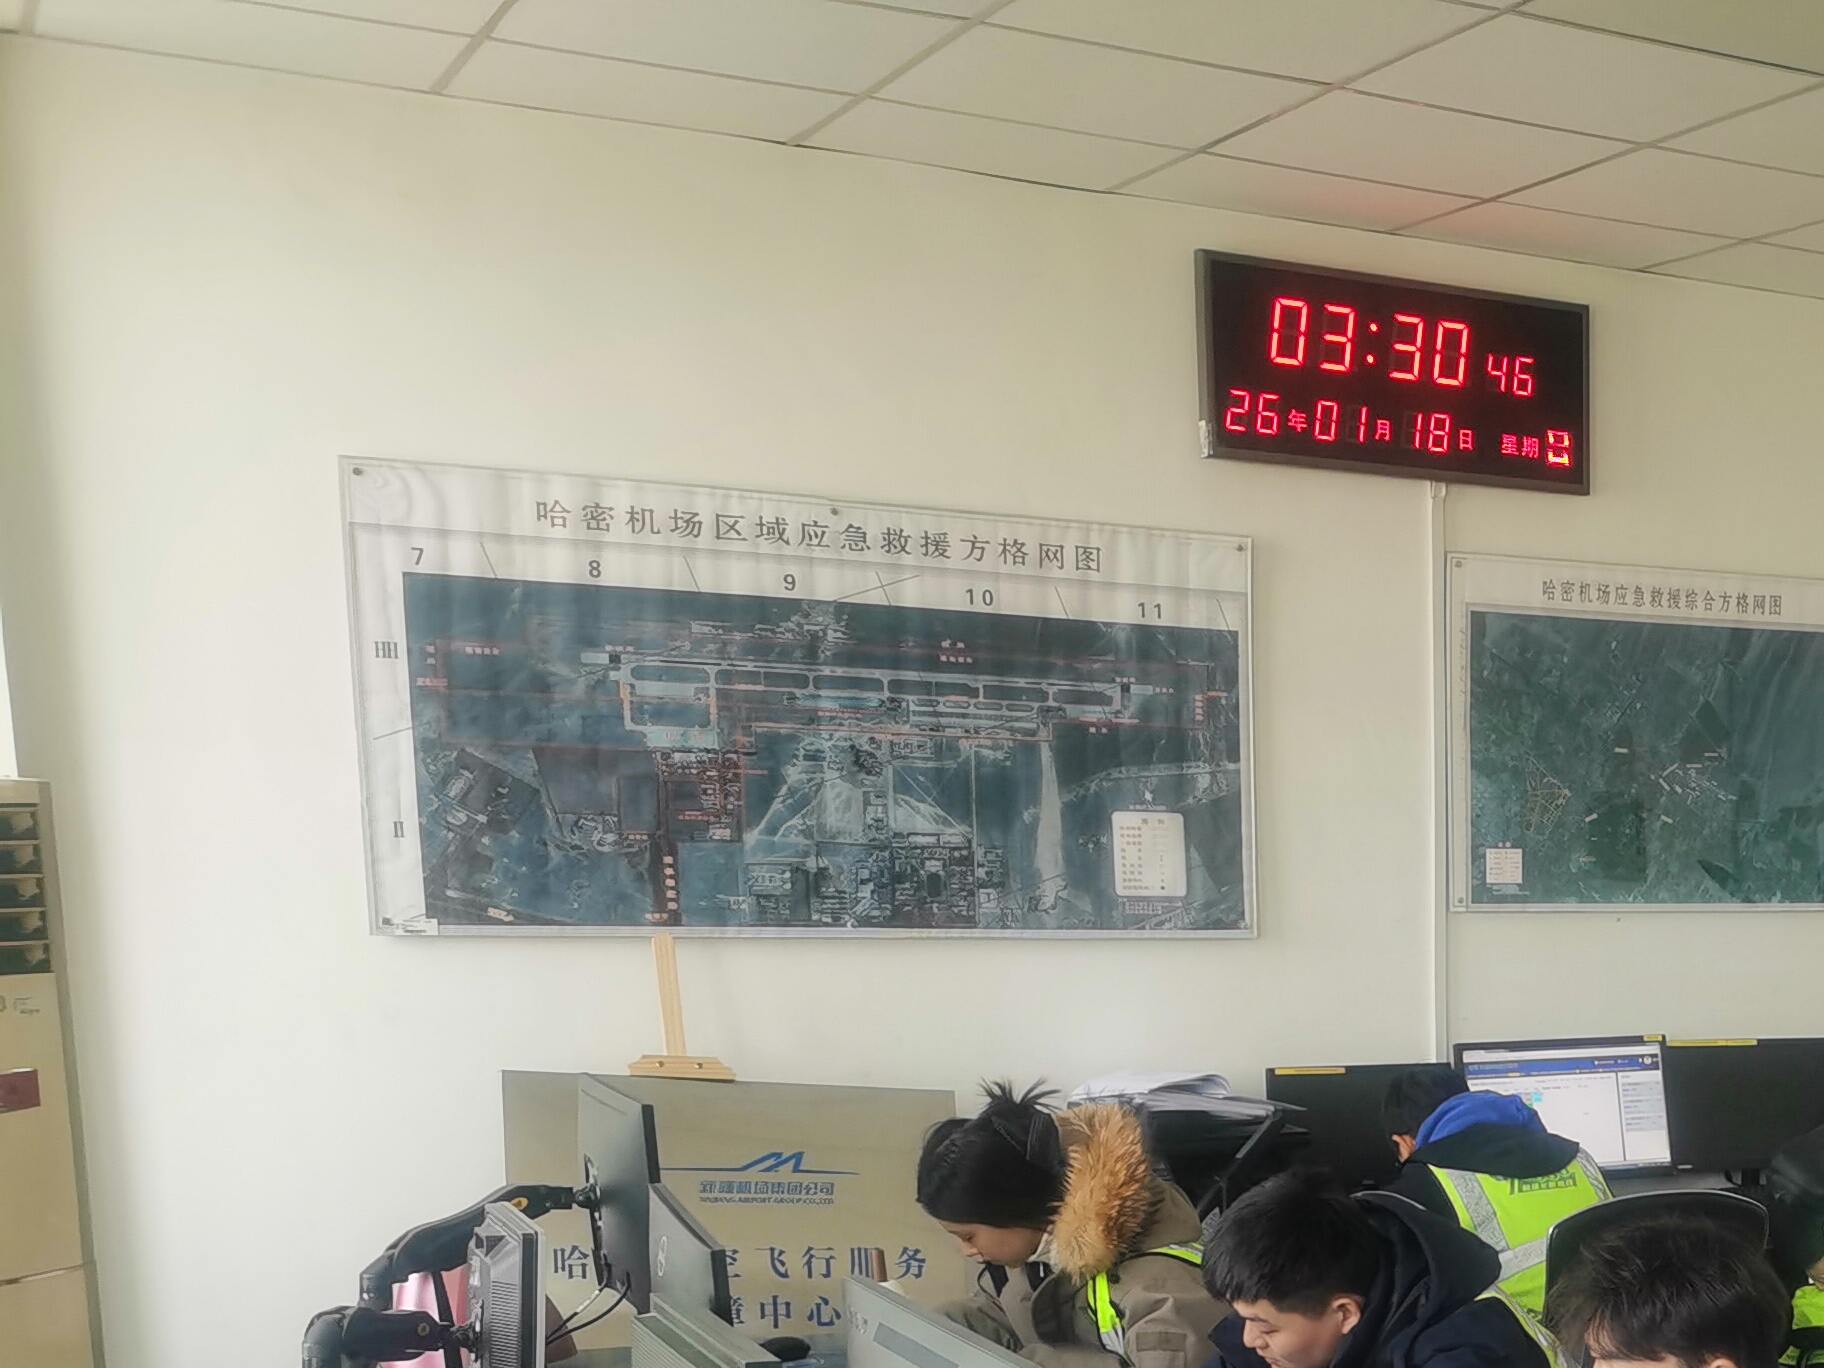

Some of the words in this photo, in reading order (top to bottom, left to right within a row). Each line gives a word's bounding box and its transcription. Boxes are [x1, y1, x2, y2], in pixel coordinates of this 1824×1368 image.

[1268, 295, 1471, 389] 03:30
[1485, 351, 1538, 399] 46
[1224, 388, 1475, 454] 26年01月18日
[535, 498, 1103, 575] 哈密机场区域应急救援方格网图
[410, 547, 425, 567] 7
[588, 559, 602, 579] 8
[783, 573, 797, 593] 9
[964, 588, 995, 607] 10
[1137, 601, 1164, 620] 11
[1541, 578, 1784, 617] 哈密机场应急救援综合方格网图
